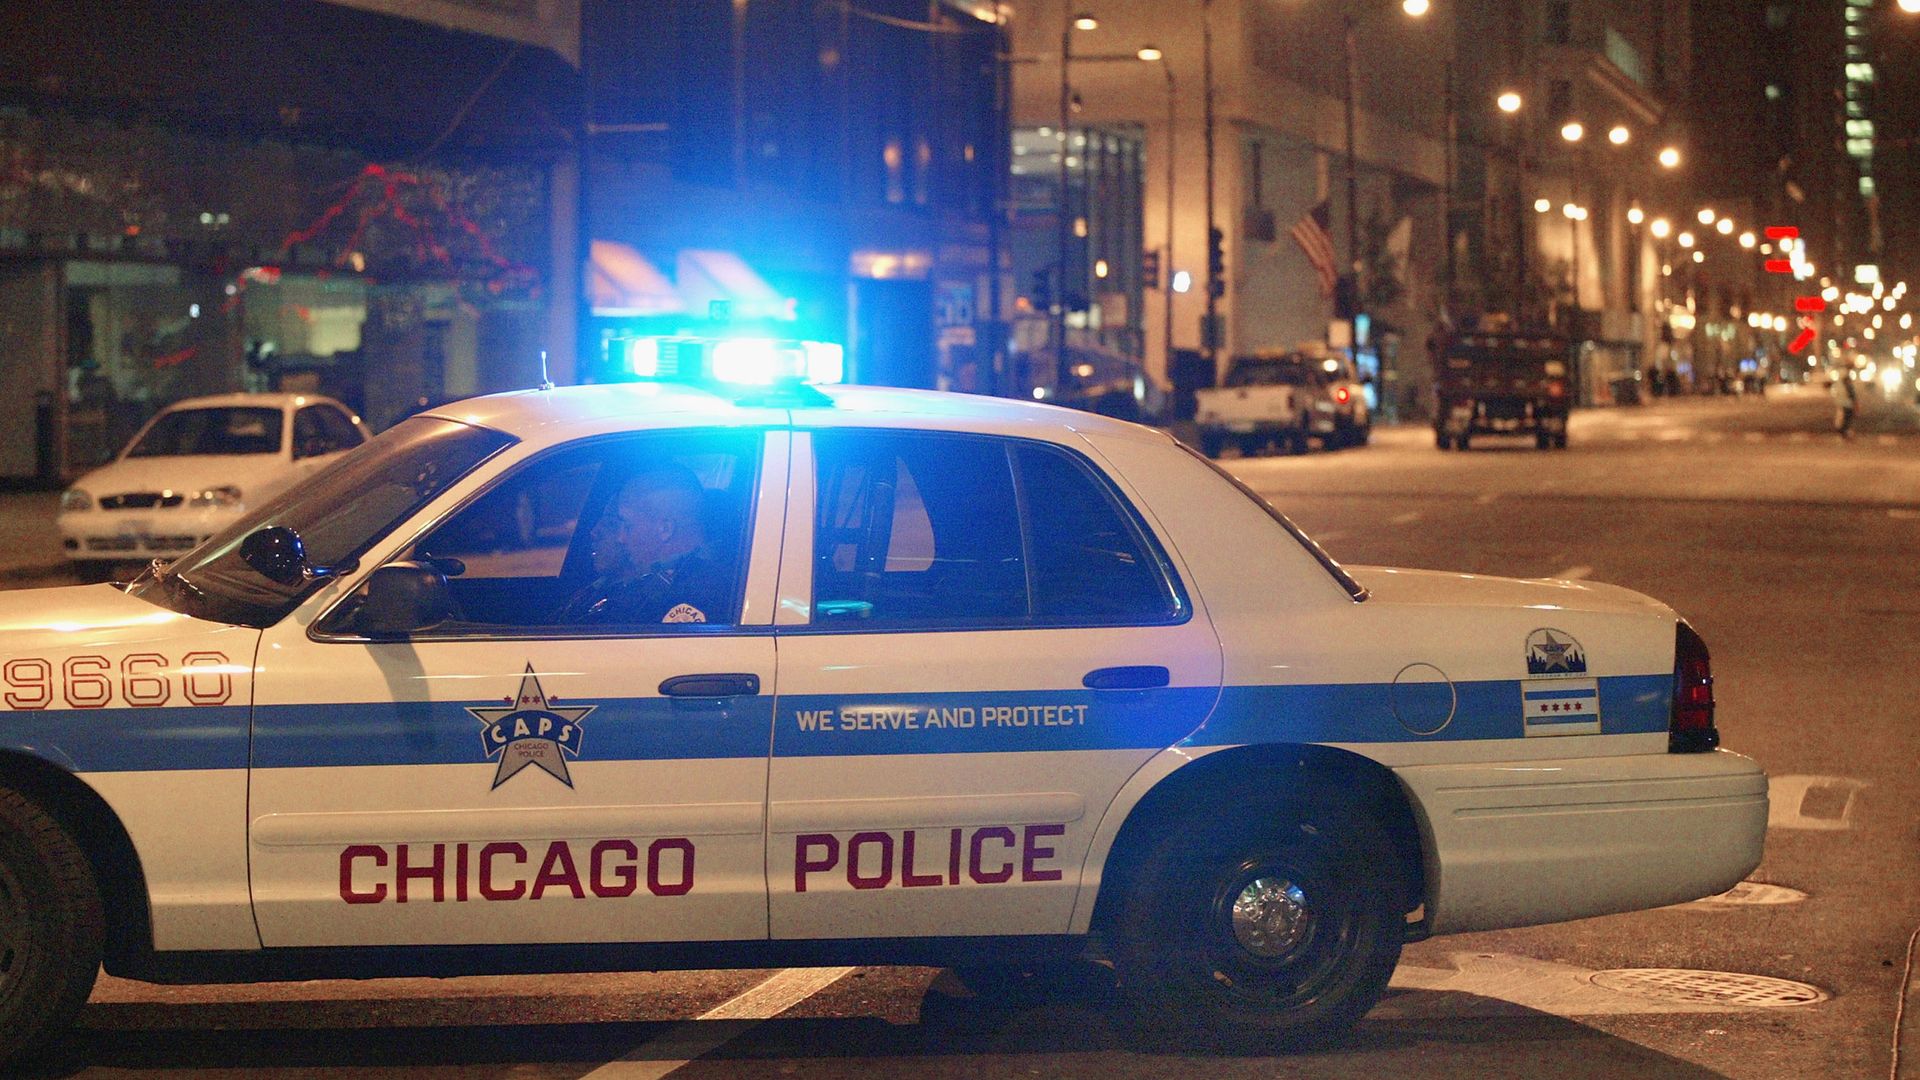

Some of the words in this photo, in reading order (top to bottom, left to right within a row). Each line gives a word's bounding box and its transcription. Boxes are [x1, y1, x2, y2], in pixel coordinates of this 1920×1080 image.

[3, 651, 232, 710] 9660
[491, 717, 573, 743] CAPS
[796, 710, 834, 731] WE
[841, 708, 919, 730] SERVE
[924, 707, 975, 728] AND
[982, 705, 1088, 727] PROTECT
[514, 742, 549, 750] CHICAGO
[519, 750, 544, 758] POLICE
[339, 838, 695, 905] CHICAGO
[794, 823, 1066, 892] POLICE
